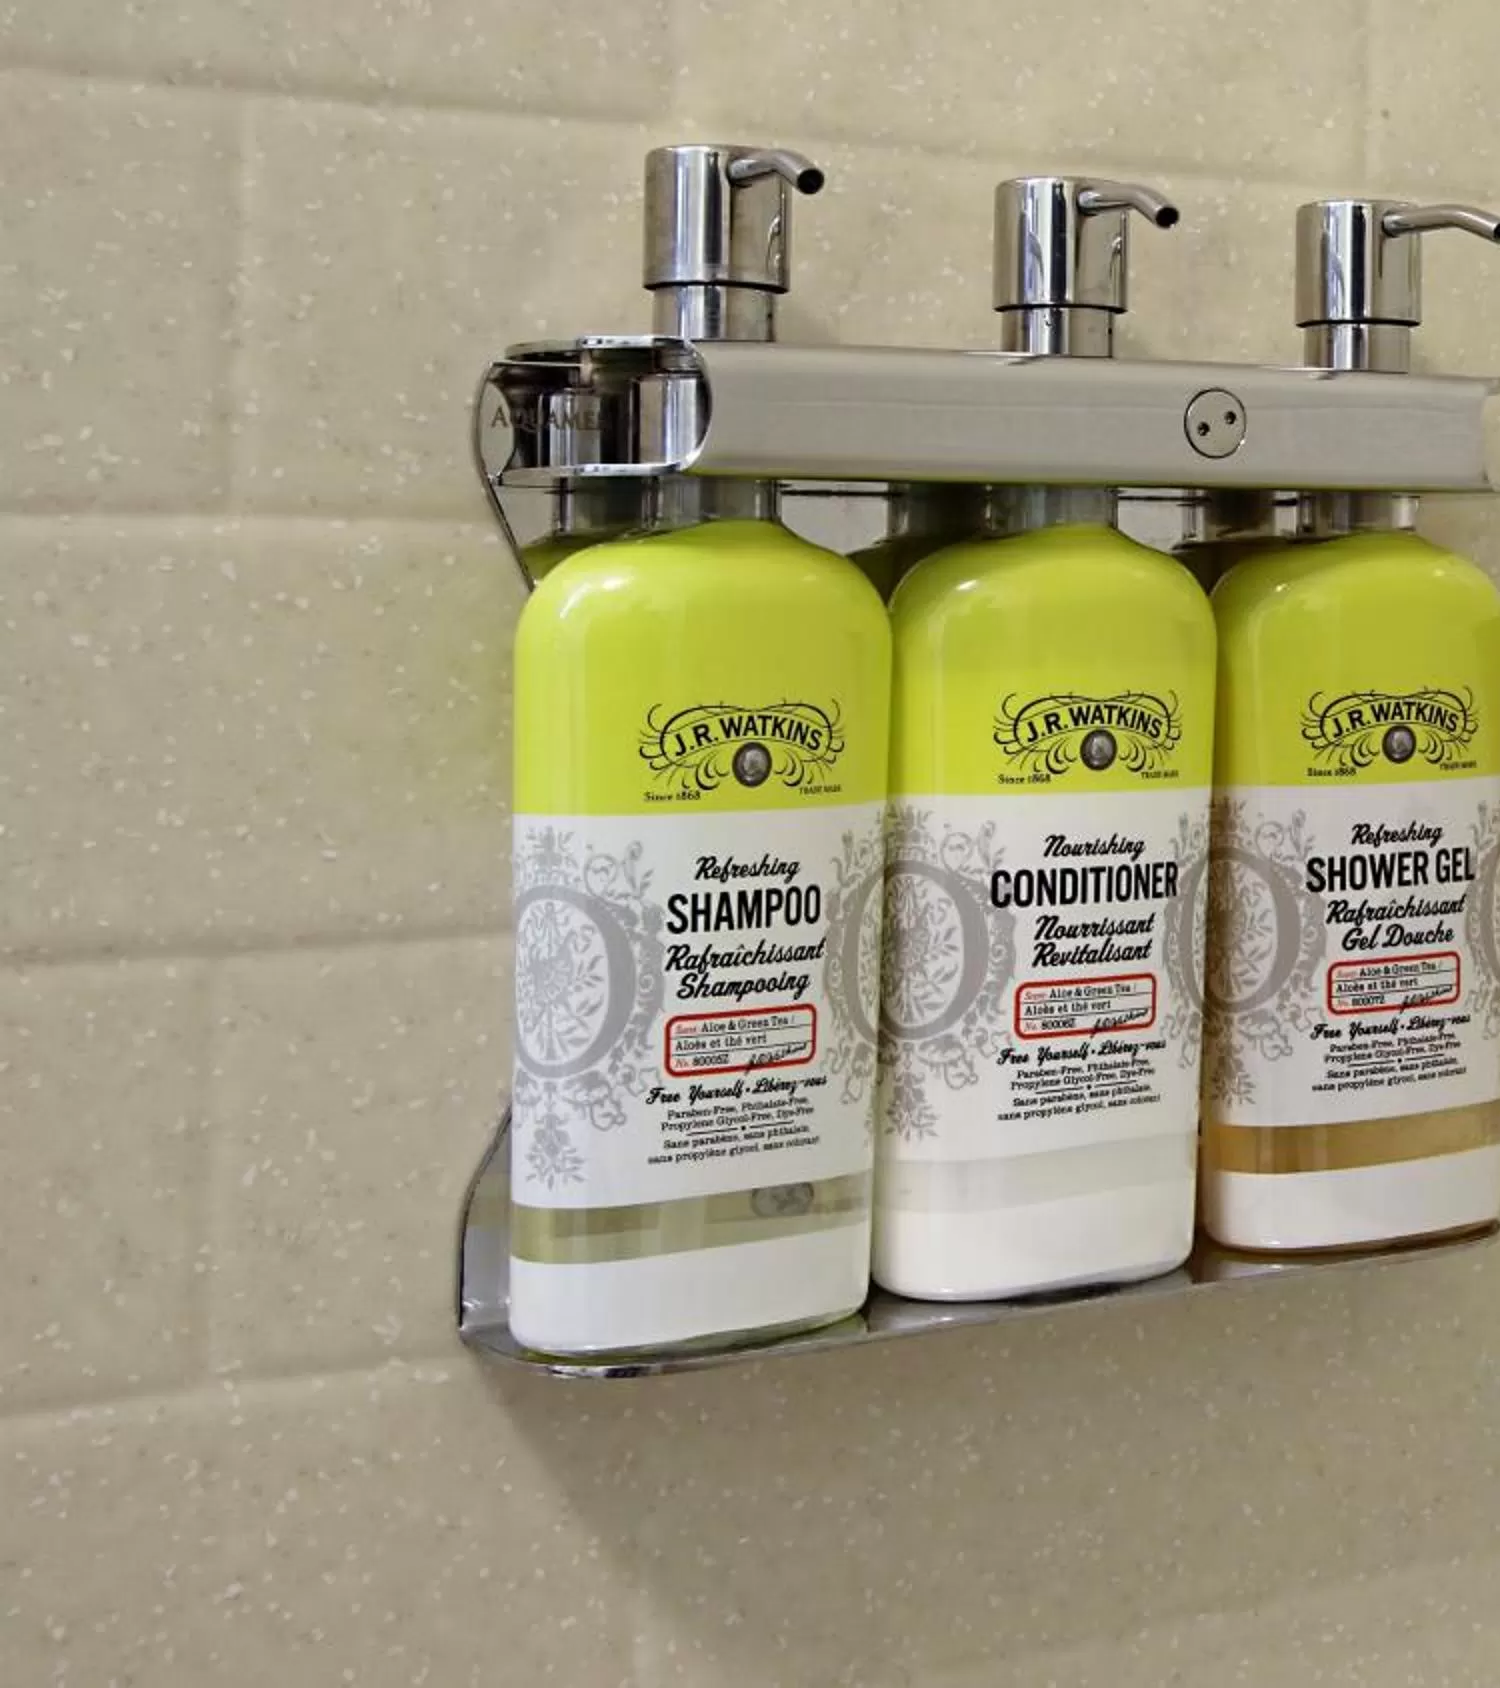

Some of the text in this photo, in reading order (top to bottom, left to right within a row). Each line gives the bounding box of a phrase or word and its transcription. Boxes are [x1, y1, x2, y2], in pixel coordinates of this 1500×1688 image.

[1026, 703, 1164, 743] J.R. WATKINS
[1333, 701, 1460, 738] J.R. WATKINS
[673, 714, 823, 756] J.R. WATKINS
[998, 773, 1025, 785] Since
[643, 790, 673, 802] Since
[1043, 833, 1145, 862] Nourishing
[1351, 820, 1443, 848] Refreshing
[695, 854, 800, 884] Refreshing
[1306, 847, 1475, 893] SHOWER GEL
[990, 861, 1179, 908] CONDITIONER
[666, 884, 821, 934] SHAMPOO
[1326, 893, 1467, 926] Rafraîchissant
[1034, 912, 1156, 940] Nourrissant
[1342, 920, 1454, 951] Gel Douche
[665, 936, 826, 974] Rafraîchissant
[1032, 937, 1153, 968] Revitalisant
[676, 970, 810, 1002] Shampooing
[1049, 987, 1073, 998] Aloe
[1074, 987, 1083, 997] &
[1084, 984, 1113, 996] Green
[1114, 983, 1131, 993] Tea
[1058, 1003, 1069, 1012] et
[1091, 1000, 1112, 1009] vert
[701, 1021, 727, 1033] Aloe
[727, 1019, 737, 1031] &
[737, 1017, 769, 1030] Green
[770, 1015, 789, 1027] Tea
[1309, 1023, 1342, 1040] Free
[1349, 1017, 1399, 1041] Yourself
[709, 1037, 721, 1048] et
[745, 1033, 768, 1045] vert
[996, 1048, 1030, 1065] Free
[1036, 1042, 1090, 1067] Yourself
[645, 1086, 681, 1105] Free
[689, 1078, 744, 1106] Yourself
[1010, 1078, 1061, 1091] Propylene
[1012, 1096, 1038, 1107] Sans
[661, 1119, 714, 1133] Propylene
[663, 1139, 690, 1149] Sans
